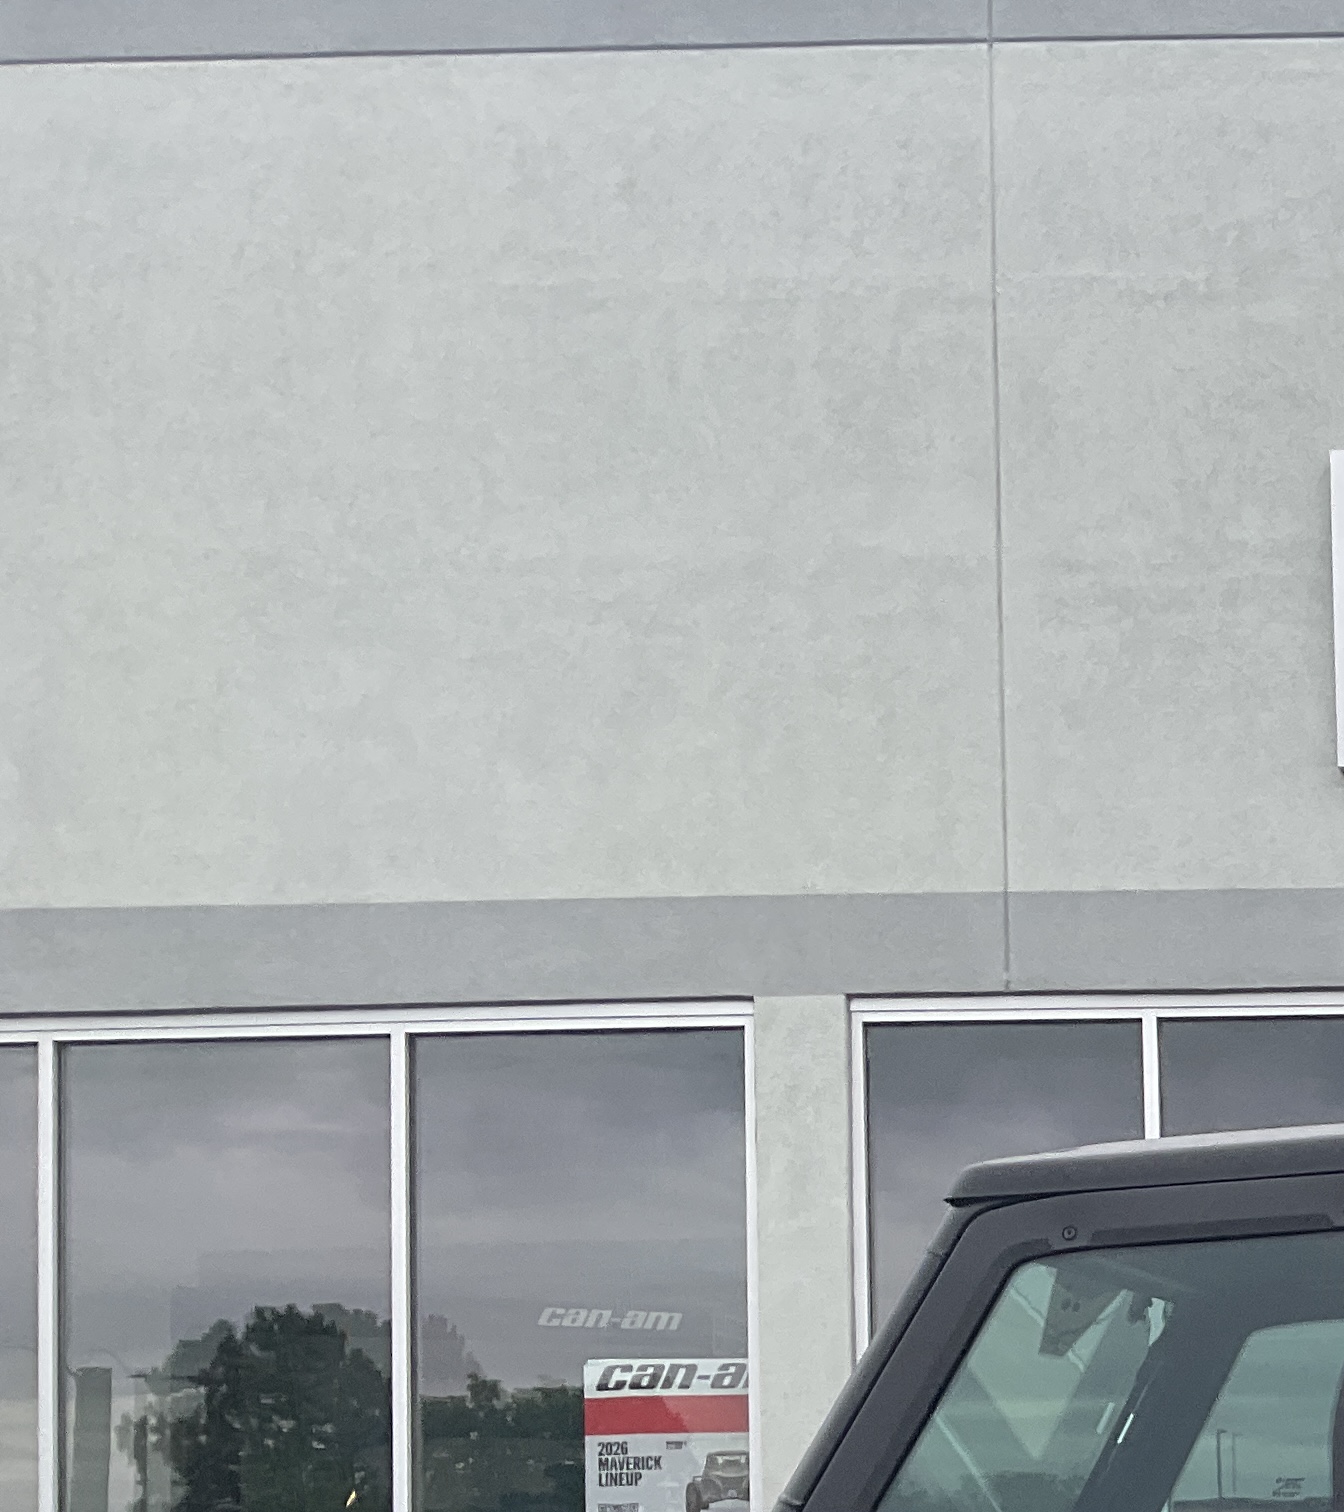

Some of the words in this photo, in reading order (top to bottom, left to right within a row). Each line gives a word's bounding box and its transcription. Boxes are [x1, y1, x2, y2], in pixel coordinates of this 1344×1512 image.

[537, 1306, 683, 1331] can-am
[596, 1361, 748, 1391] can-a
[598, 1441, 628, 1456] 2026
[598, 1456, 662, 1471] MAVERICK
[598, 1472, 643, 1487] LINEUP
